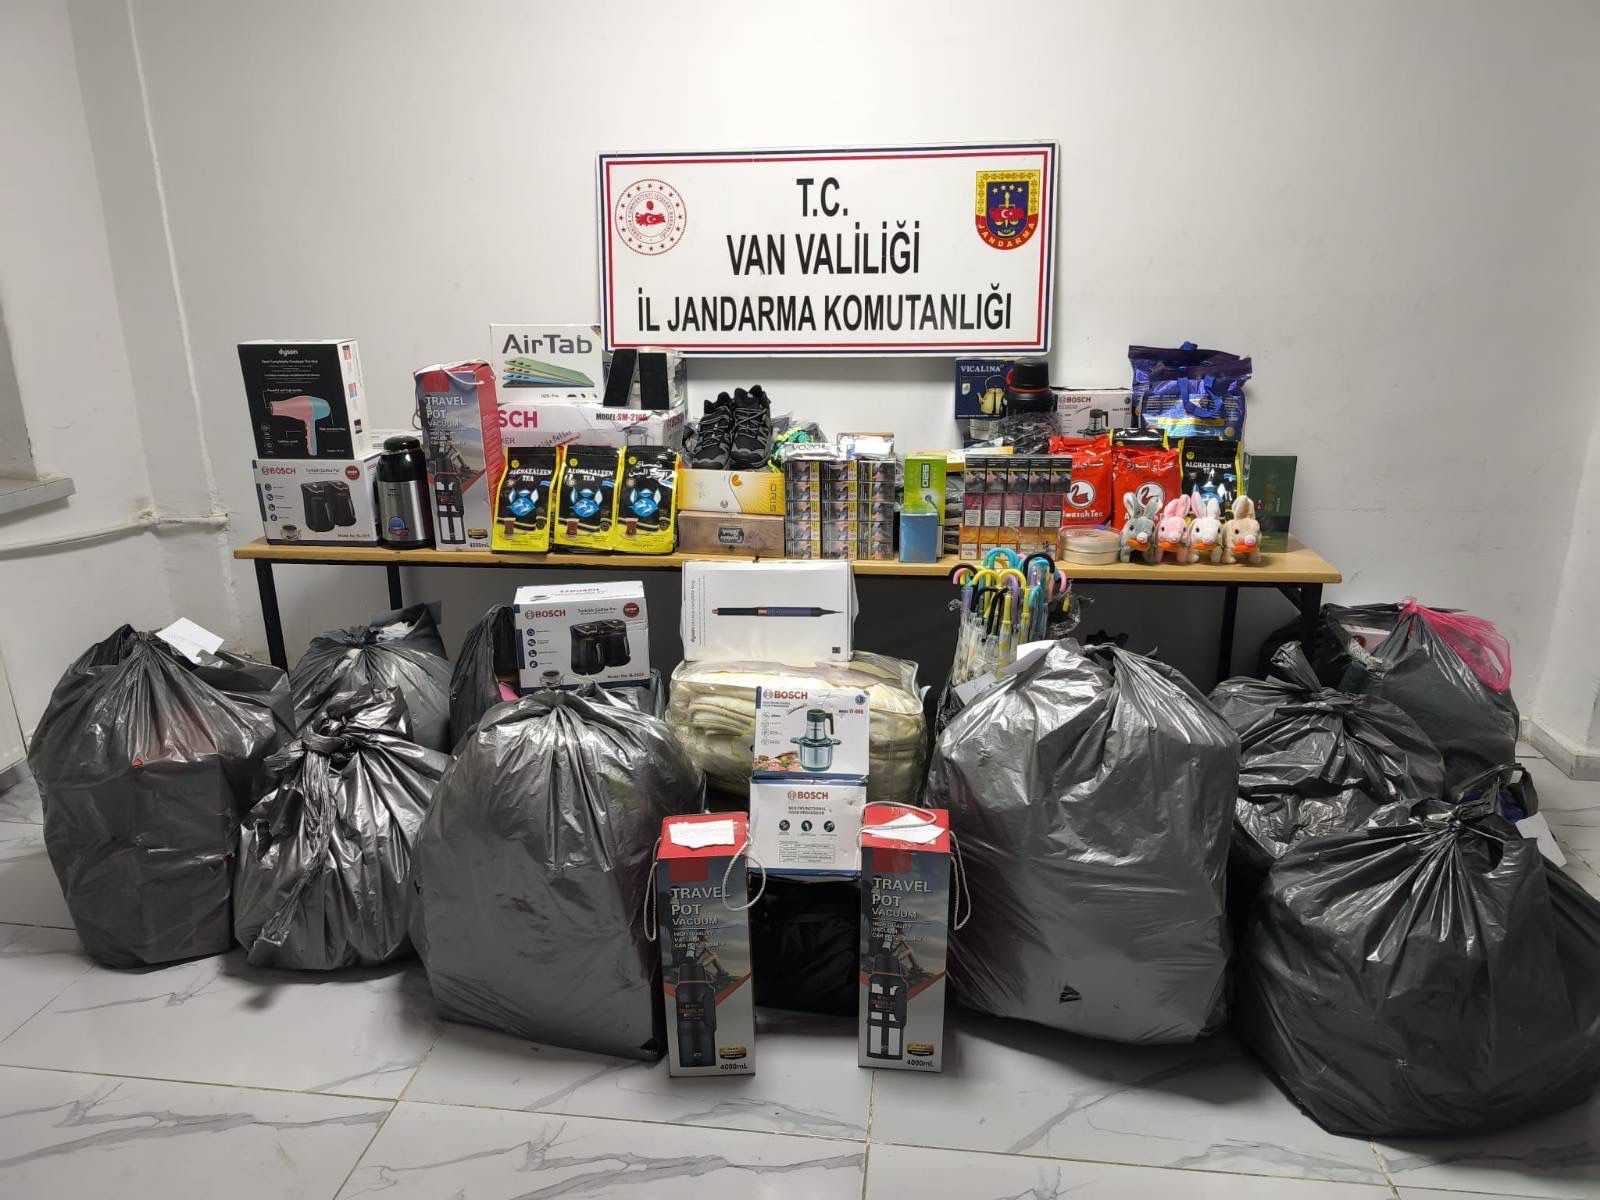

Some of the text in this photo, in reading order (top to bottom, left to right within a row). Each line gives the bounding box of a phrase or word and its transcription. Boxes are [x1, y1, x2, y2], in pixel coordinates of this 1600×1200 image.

[796, 176, 849, 217] T.C.
[726, 219, 920, 276] VAN VALİLİĞİ
[637, 281, 1012, 333] İL JANDARMA KOMUTANLIĞI
[501, 333, 593, 354] AirTab
[425, 395, 466, 406] TRAVEL
[426, 409, 447, 419] POT
[270, 466, 296, 475] BOSCH
[535, 609, 566, 618] BOSCH
[774, 690, 808, 700] BOSCH
[797, 791, 829, 800] BOSCH
[873, 877, 933, 893] TRAVEL
[670, 886, 731, 899] TRAVEL
[872, 894, 901, 907] POT
[671, 903, 701, 916] POT
[871, 907, 917, 919] VACUUM
[672, 917, 719, 926] VACUUM
